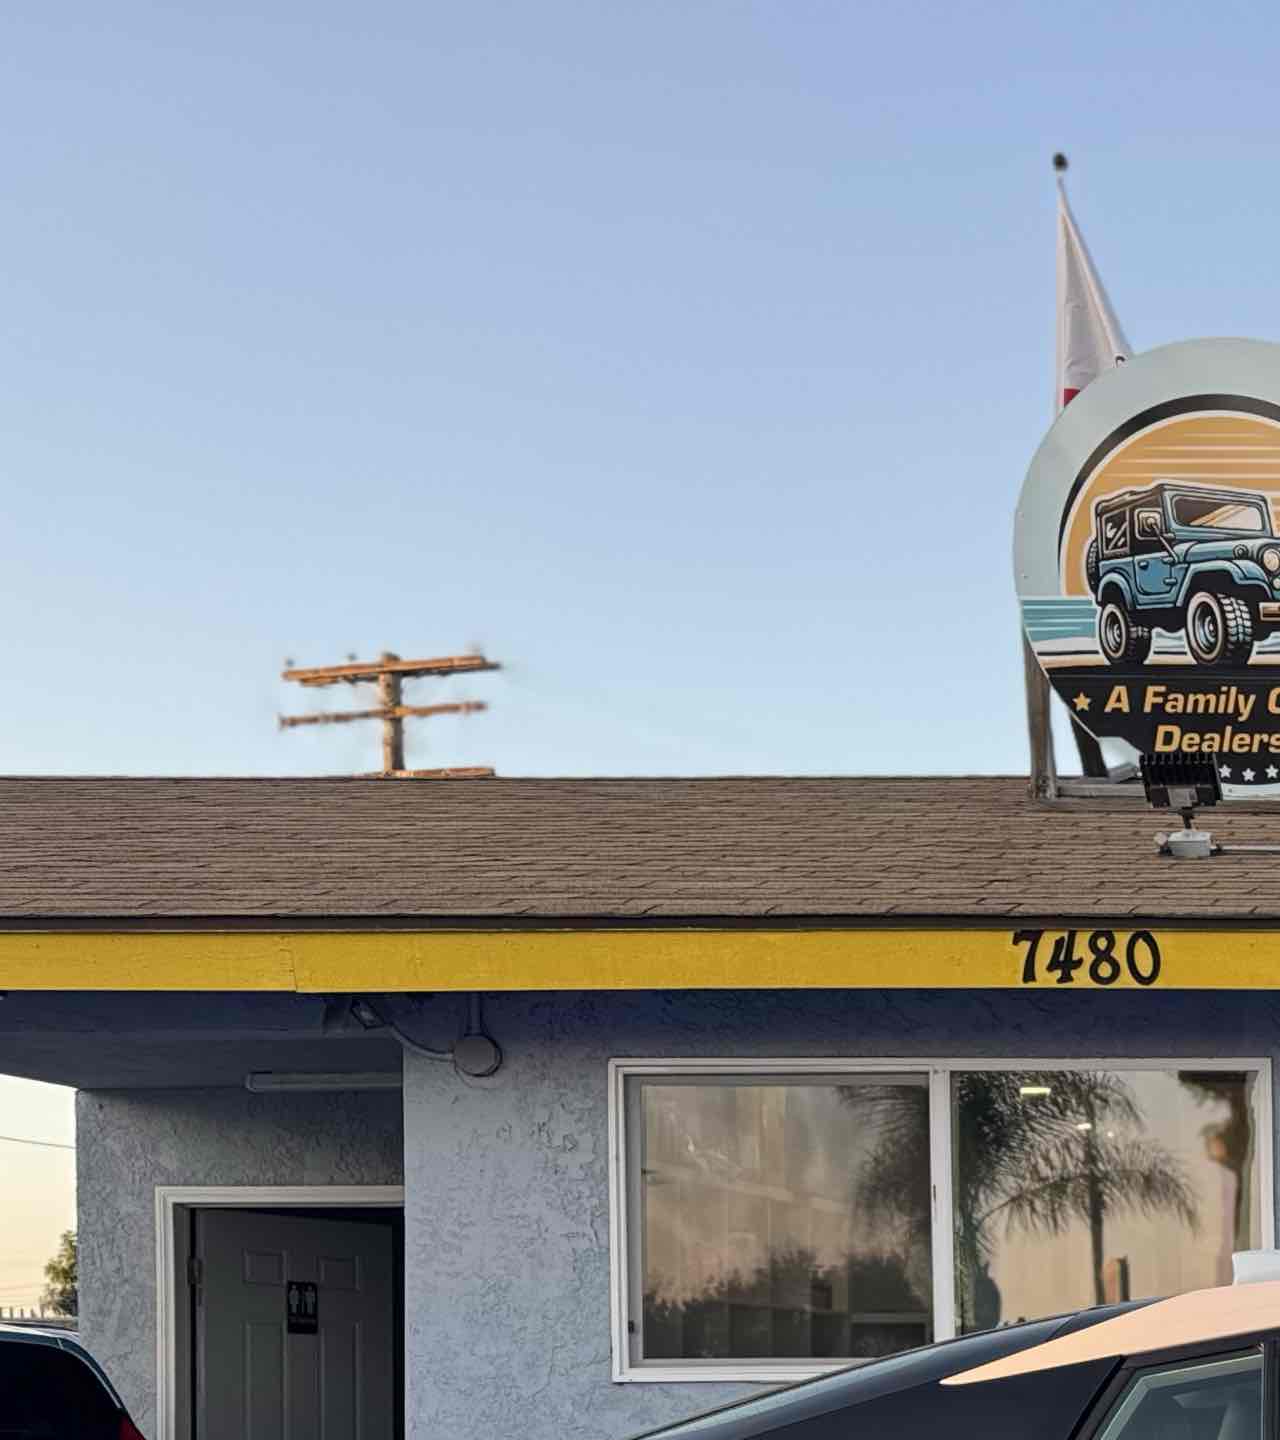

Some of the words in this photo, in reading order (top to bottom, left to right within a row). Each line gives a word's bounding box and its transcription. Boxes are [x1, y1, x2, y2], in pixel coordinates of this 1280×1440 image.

[1104, 685, 1130, 713] A
[1143, 686, 1258, 722] Family
[1012, 930, 1161, 986] 7480
